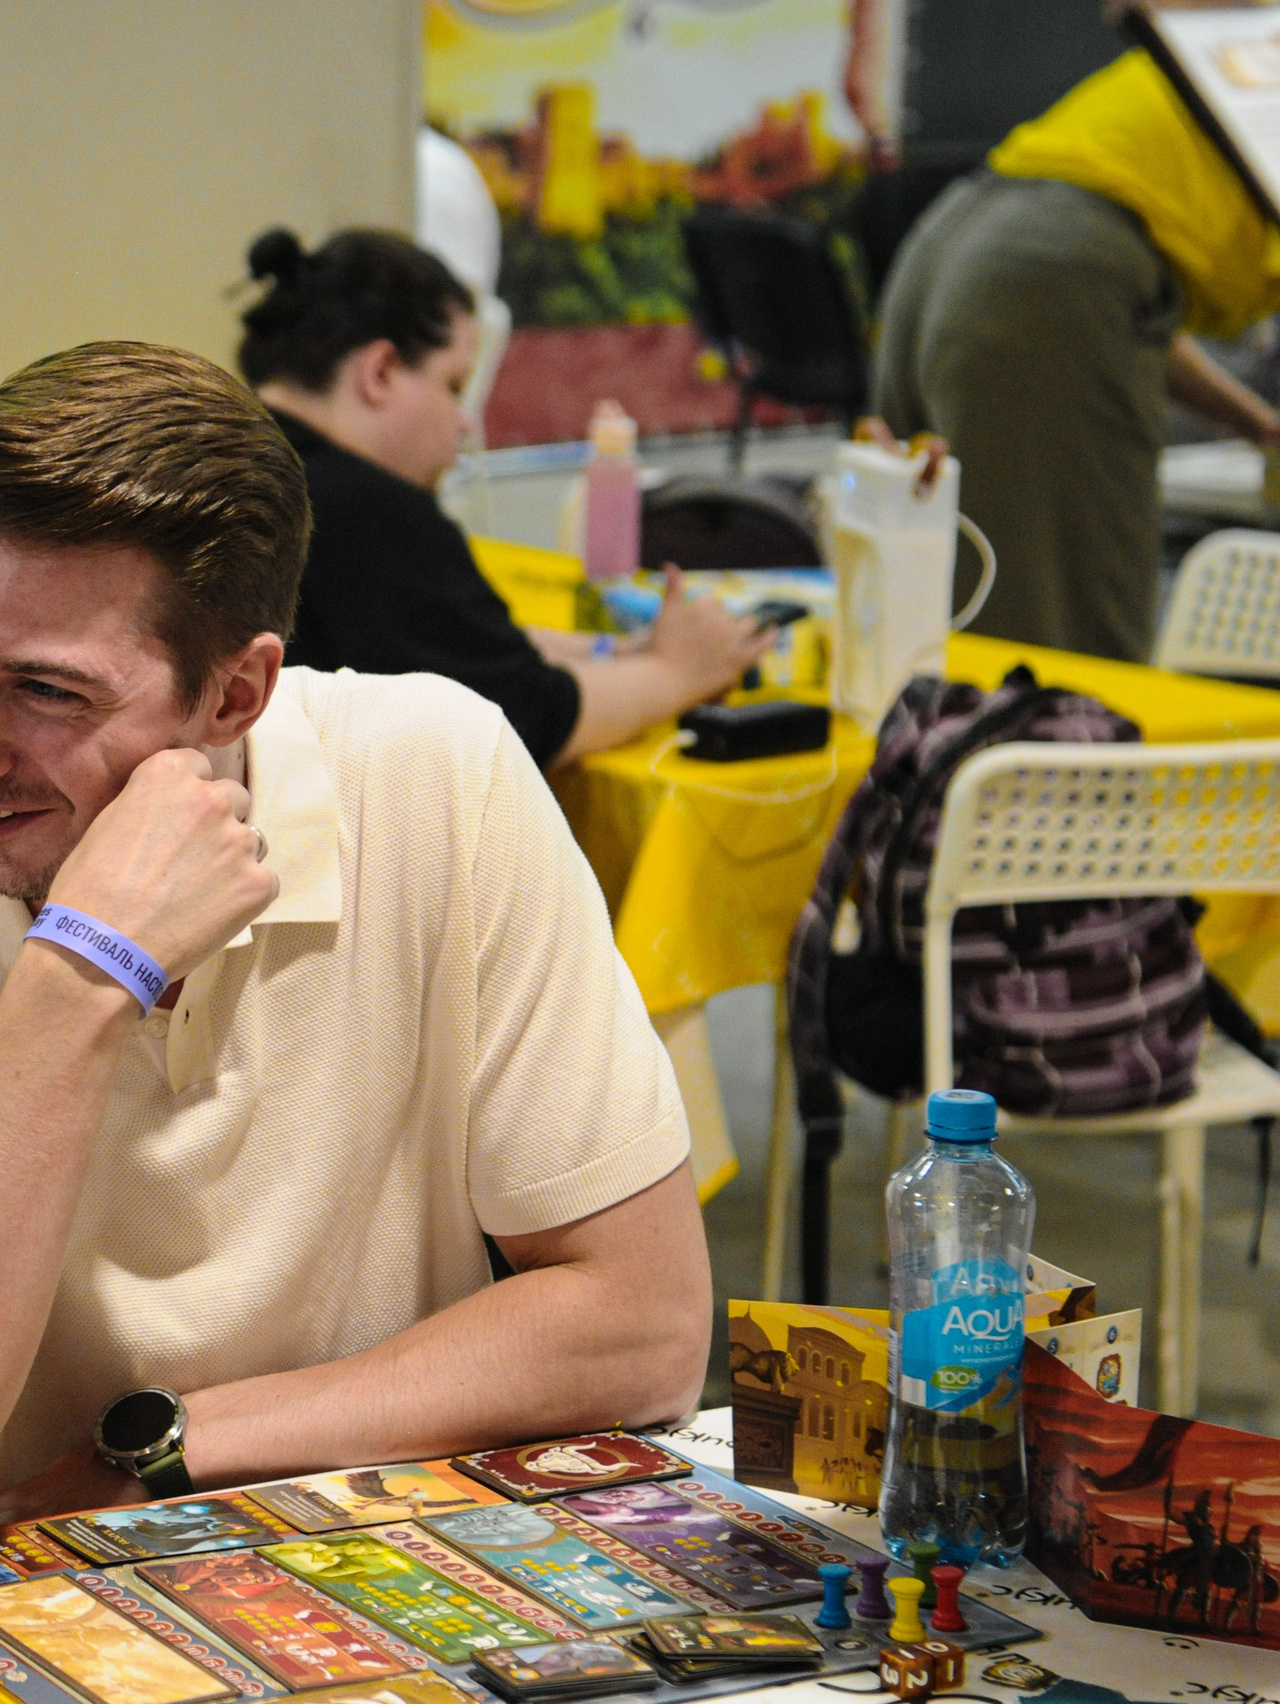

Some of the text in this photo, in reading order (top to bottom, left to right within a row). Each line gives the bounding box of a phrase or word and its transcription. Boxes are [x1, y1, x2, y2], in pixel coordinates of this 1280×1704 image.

[55, 915, 135, 971] ФЕСТИВАЛЬ
[941, 1300, 1024, 1341] AQUA
[938, 1370, 982, 1385] 100%
[881, 1662, 899, 1686] 3
[906, 1669, 928, 1689] 2
[946, 1659, 955, 1682] 1
